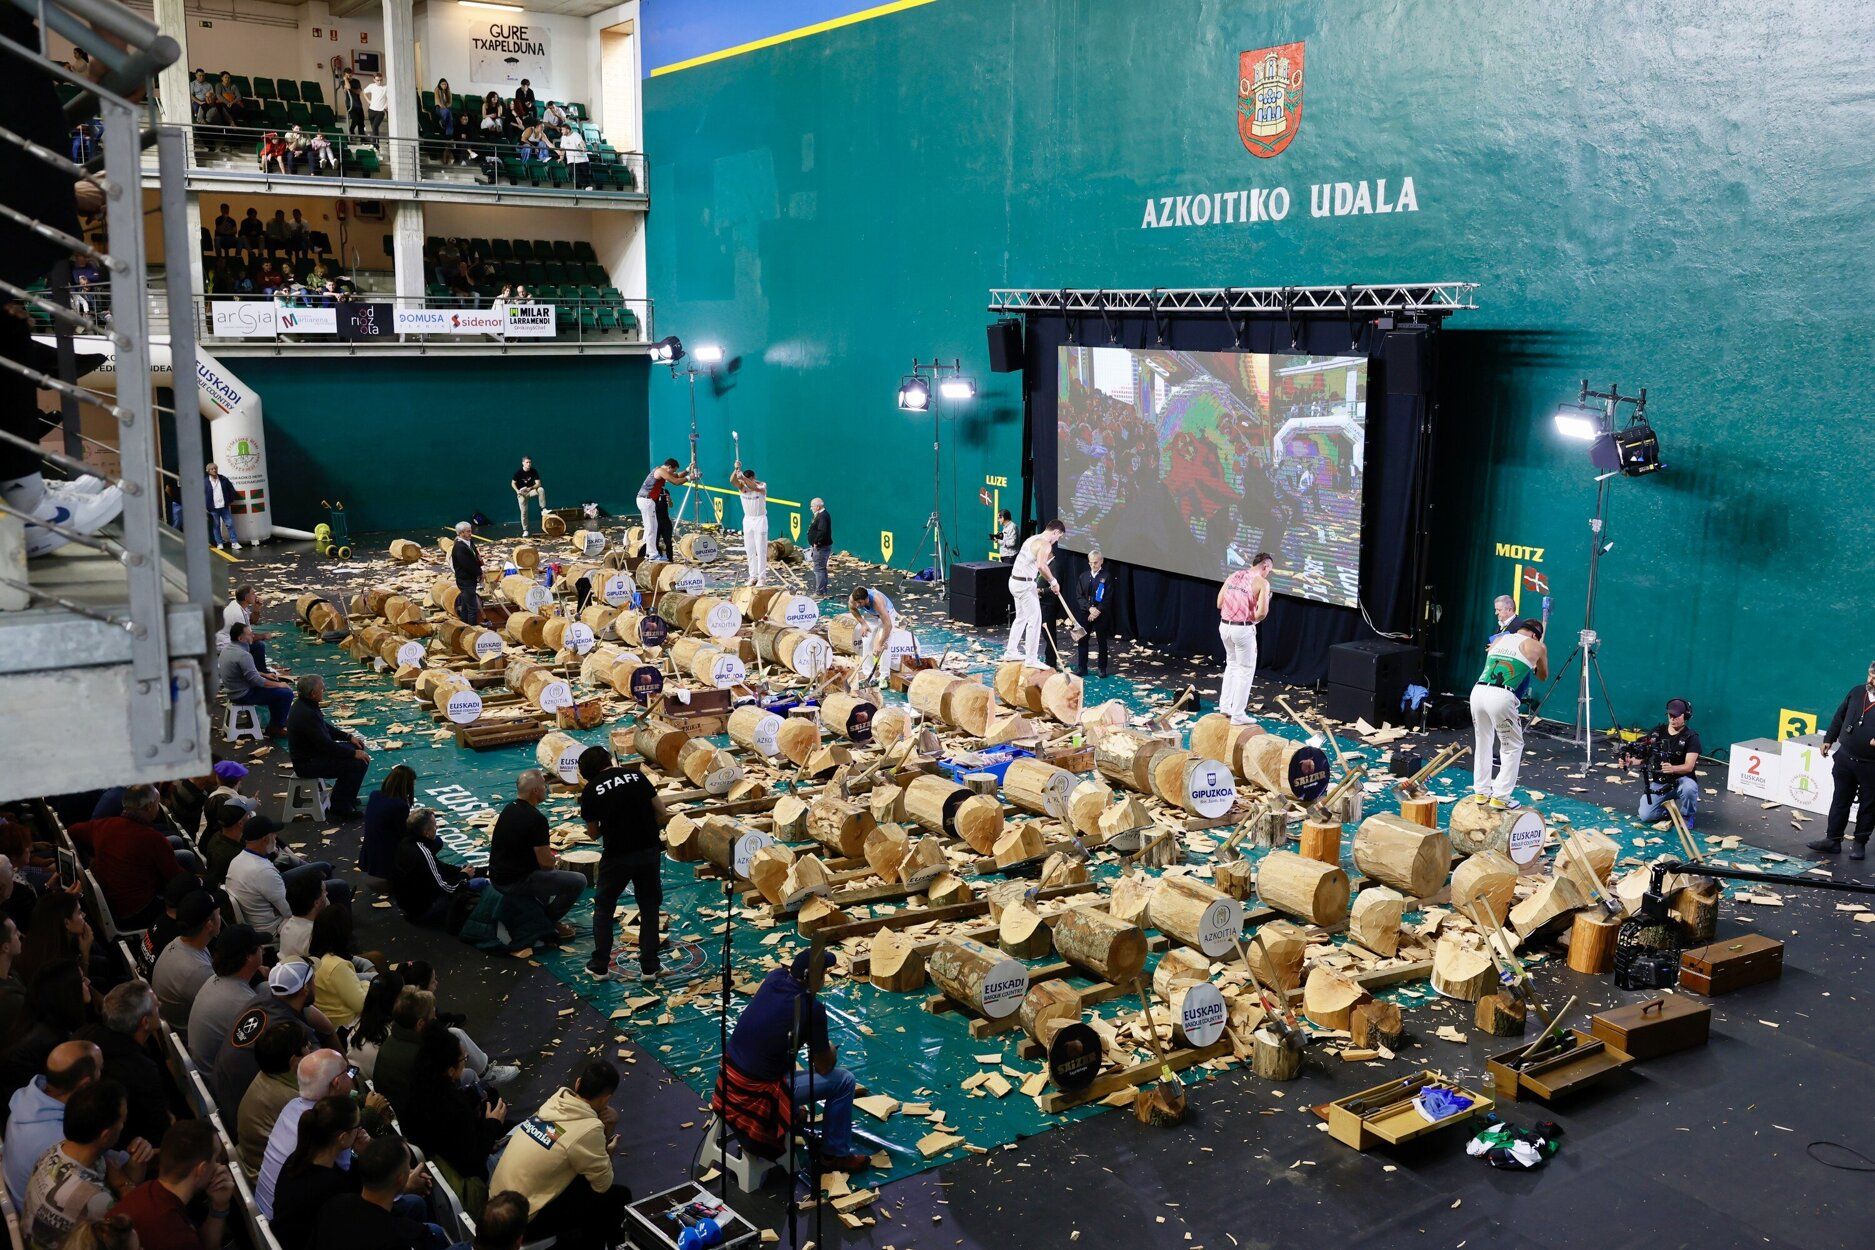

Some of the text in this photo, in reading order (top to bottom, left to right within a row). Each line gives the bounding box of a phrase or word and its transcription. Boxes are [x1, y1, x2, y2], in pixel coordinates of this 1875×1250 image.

[490, 24, 529, 41] GURE
[472, 38, 545, 56] TXAPELDUNA
[1141, 176, 1419, 229] AZKOITIKO UDALA
[400, 314, 444, 322] DOMUSA
[520, 308, 549, 317] MILAR
[207, 386, 235, 410] COUNTRY
[986, 475, 1008, 487] LUZE
[793, 516, 799, 529] 9
[883, 535, 891, 549] 8
[696, 548, 717, 556] GIPUZKOA
[1496, 543, 1544, 562] MOTZ
[787, 613, 817, 621] GIPUZKOA
[1786, 717, 1808, 739] 3
[1747, 755, 1761, 776] 2
[1801, 749, 1812, 772] 1
[595, 773, 640, 796] STAFF
[1741, 773, 1766, 784] EUSKADI
[1191, 788, 1233, 799] GIPUZKOA
[1512, 830, 1541, 842] EUSKADI
[1204, 927, 1237, 942] AZKOITIA
[984, 978, 1025, 994] EUSKADI
[1001, 988, 1023, 998] COUNTRY
[1183, 1003, 1222, 1021] EUSKADI
